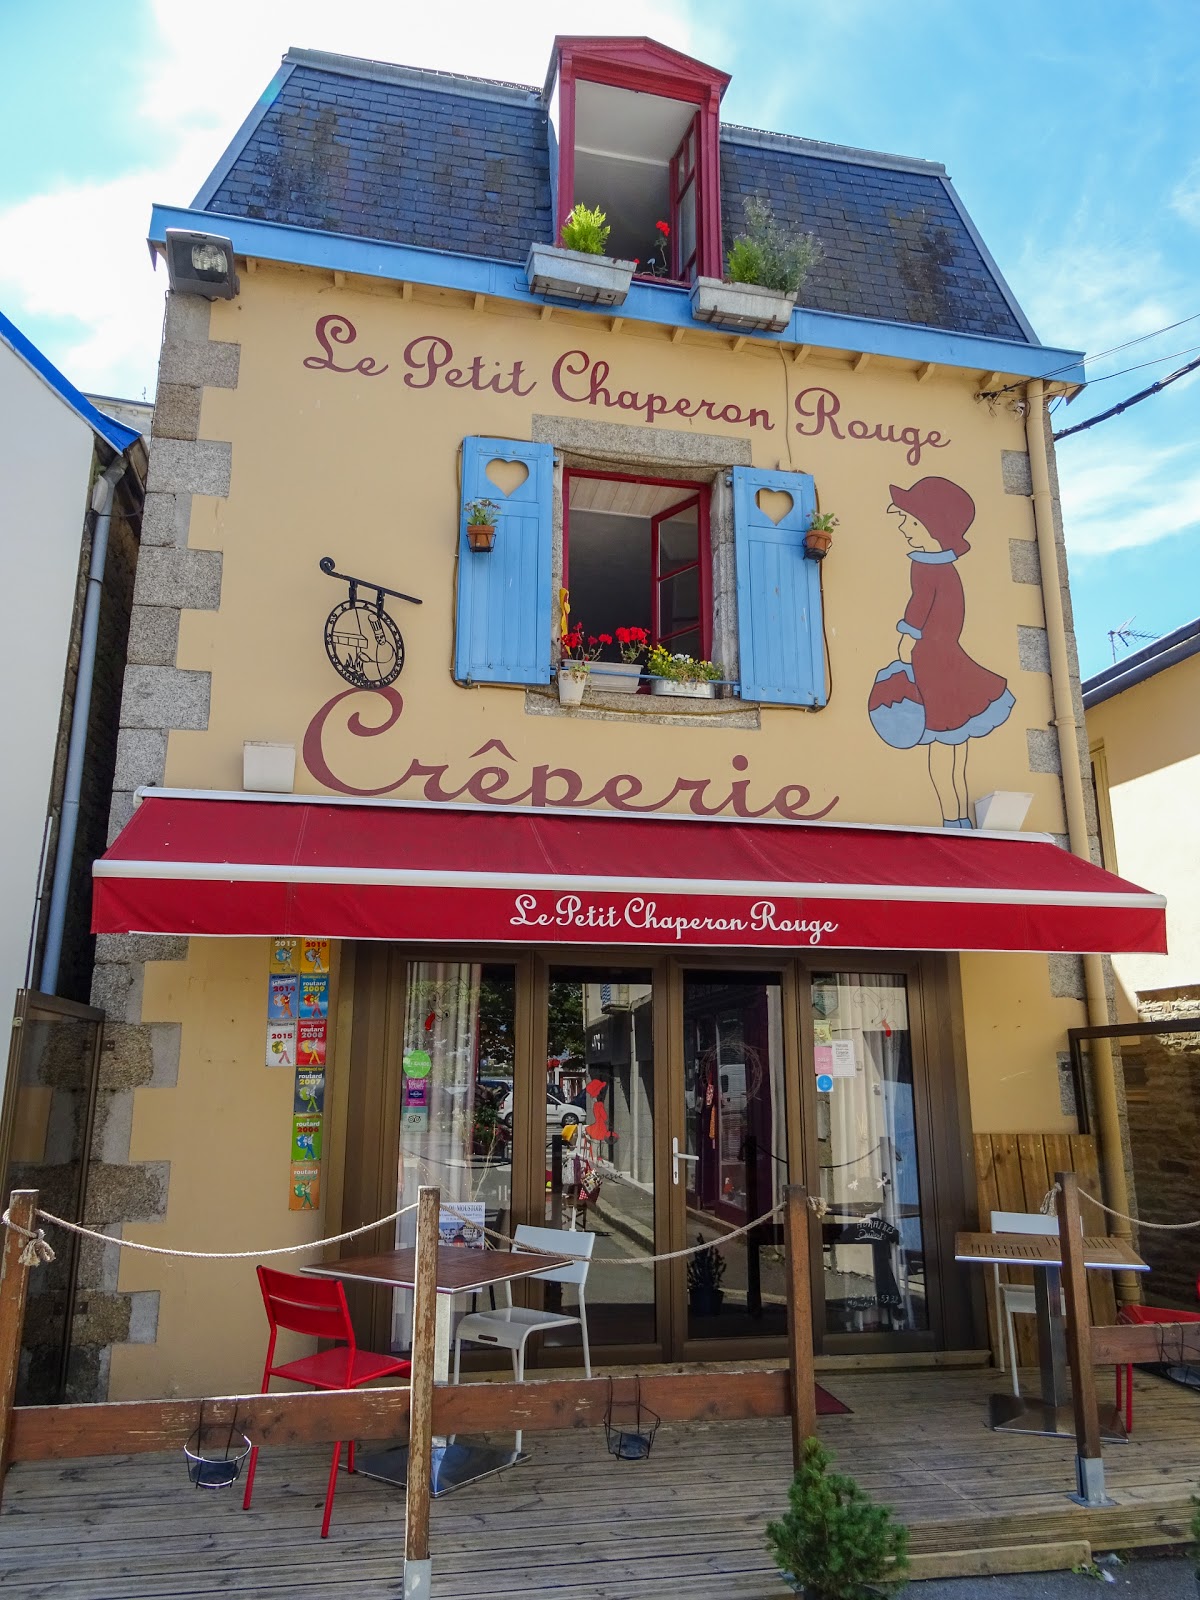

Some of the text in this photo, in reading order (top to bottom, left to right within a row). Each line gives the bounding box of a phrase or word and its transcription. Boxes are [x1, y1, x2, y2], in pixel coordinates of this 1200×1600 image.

[303, 314, 951, 467] Le Petit Chaperon Rouge
[302, 686, 840, 821] Crêperie
[509, 893, 839, 945] Le Petit Chaperon Rouge
